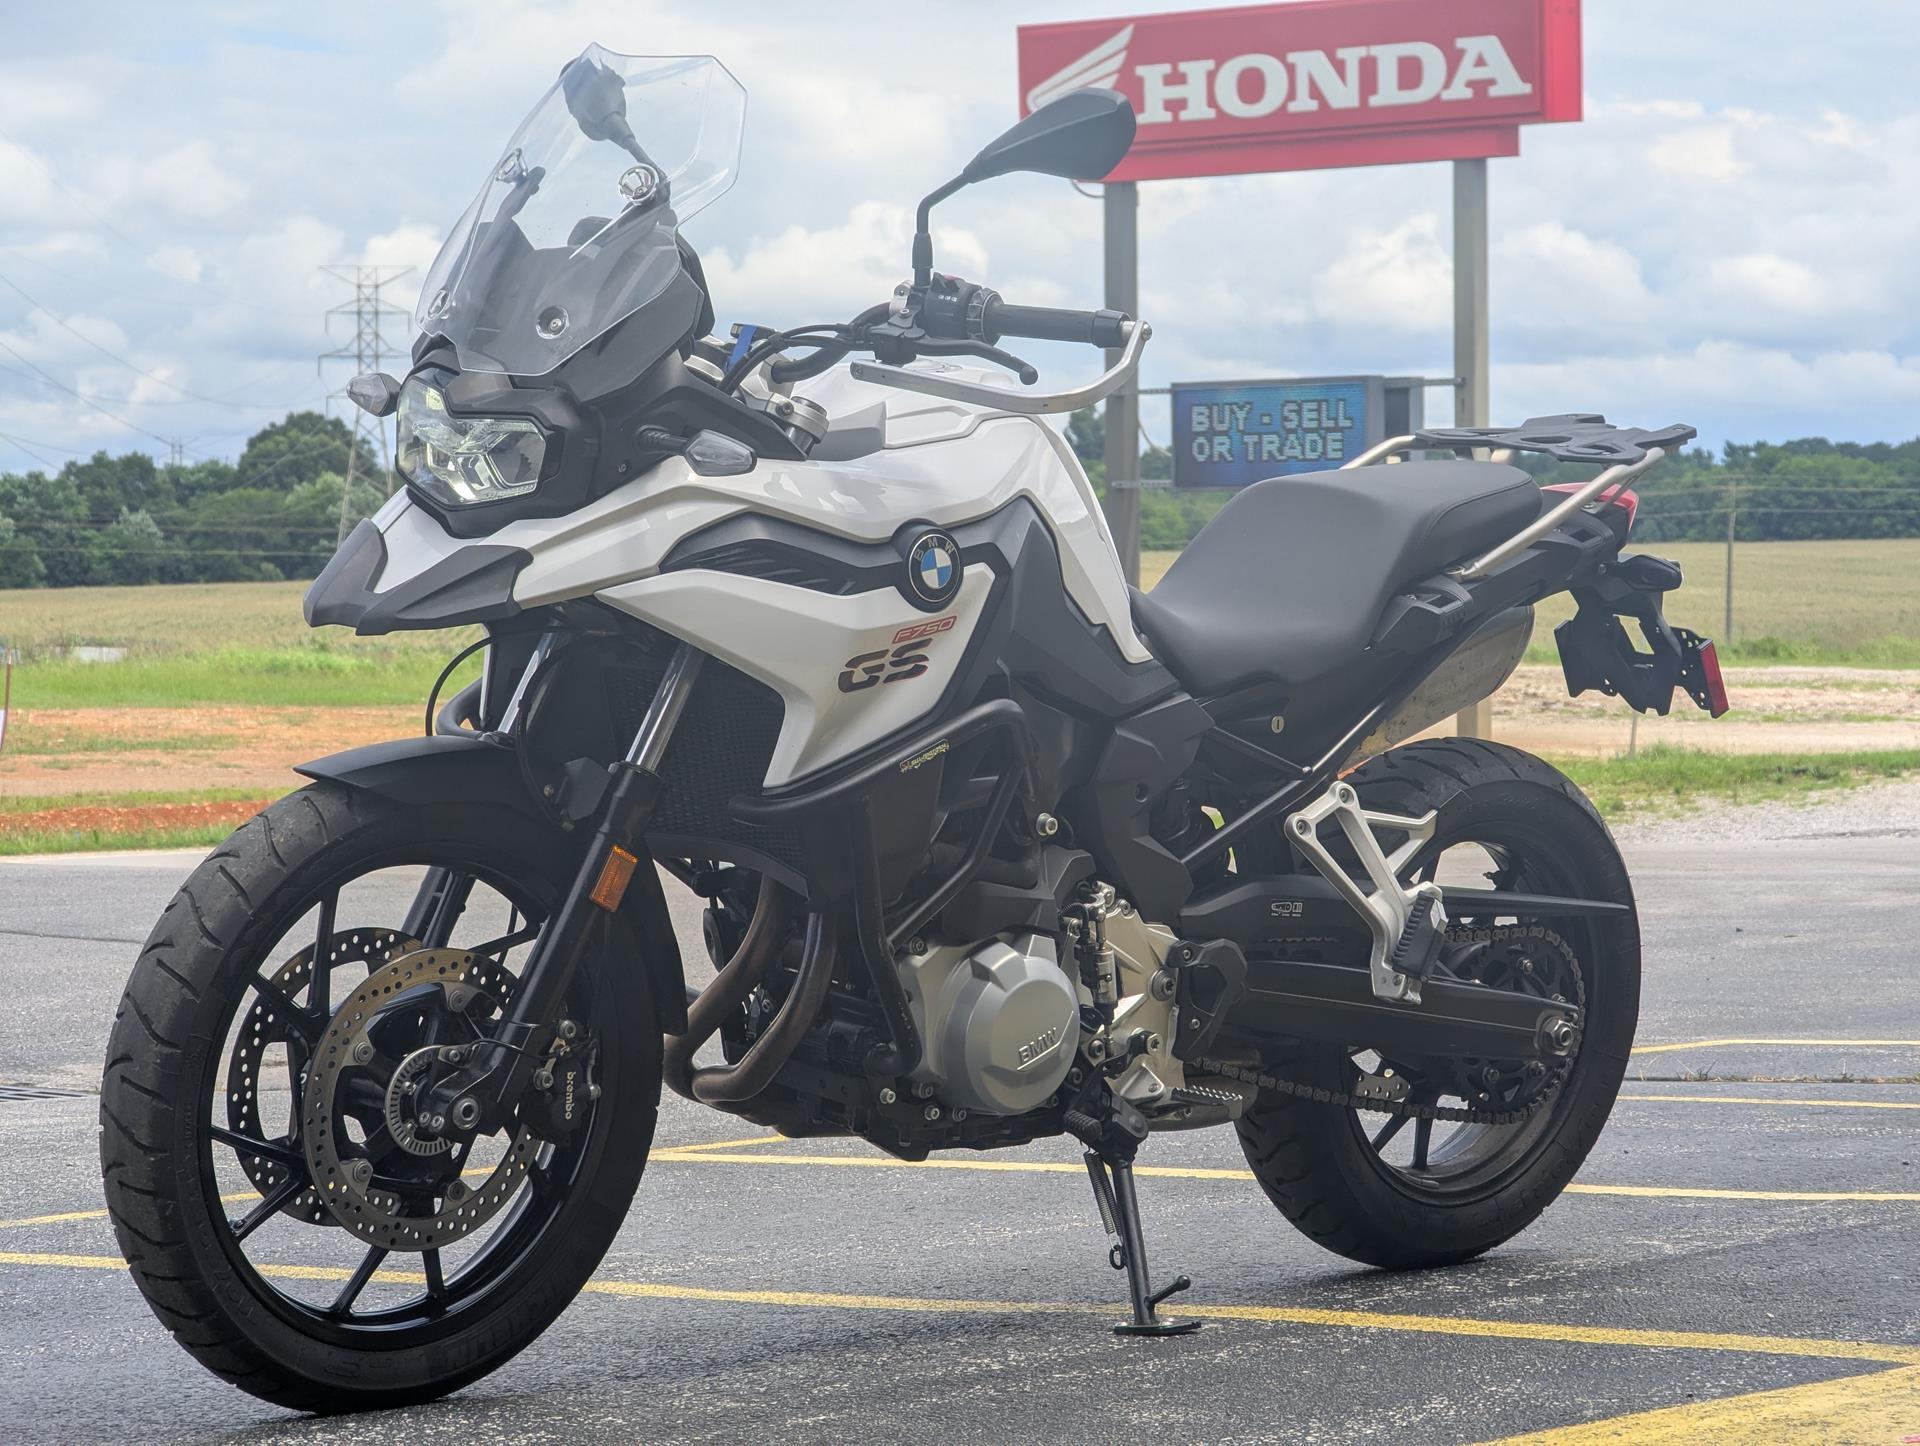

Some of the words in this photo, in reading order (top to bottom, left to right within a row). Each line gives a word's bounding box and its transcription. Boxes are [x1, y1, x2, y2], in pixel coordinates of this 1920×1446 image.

[1135, 34, 1532, 125] HONDA
[1191, 403, 1250, 432] BUY
[1282, 400, 1353, 430] SELL
[1192, 435, 1233, 462] OR
[1243, 431, 1343, 461] TRADE
[913, 537, 955, 561] BMW
[895, 618, 954, 642] F750
[838, 638, 933, 693] GS
[1018, 1026, 1058, 1065] BMW
[565, 1071, 576, 1120] brembo
